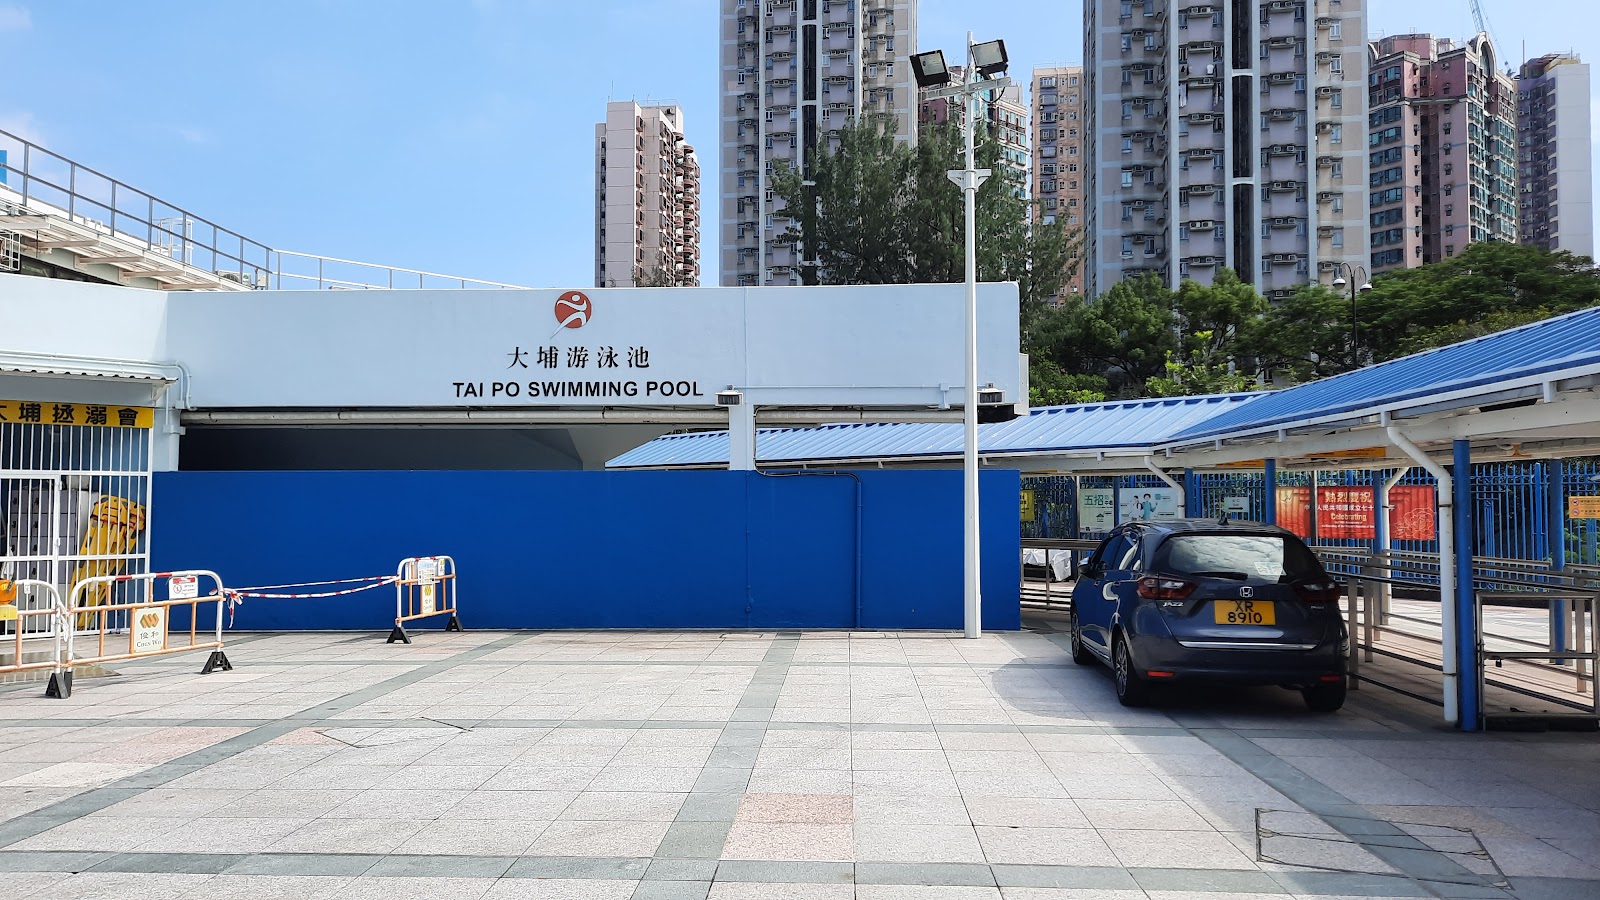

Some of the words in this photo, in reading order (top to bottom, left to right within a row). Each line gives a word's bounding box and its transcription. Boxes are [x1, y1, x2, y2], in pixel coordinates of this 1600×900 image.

[506, 346, 650, 369] 大埔游泳池
[453, 382, 484, 398] TAI
[491, 381, 520, 397] PO
[528, 381, 638, 397] SWIMMING
[646, 381, 704, 397] POOL
[1330, 512, 1367, 521] Celebrating
[1235, 600, 1254, 612] XR
[1227, 611, 1263, 624] 8910
